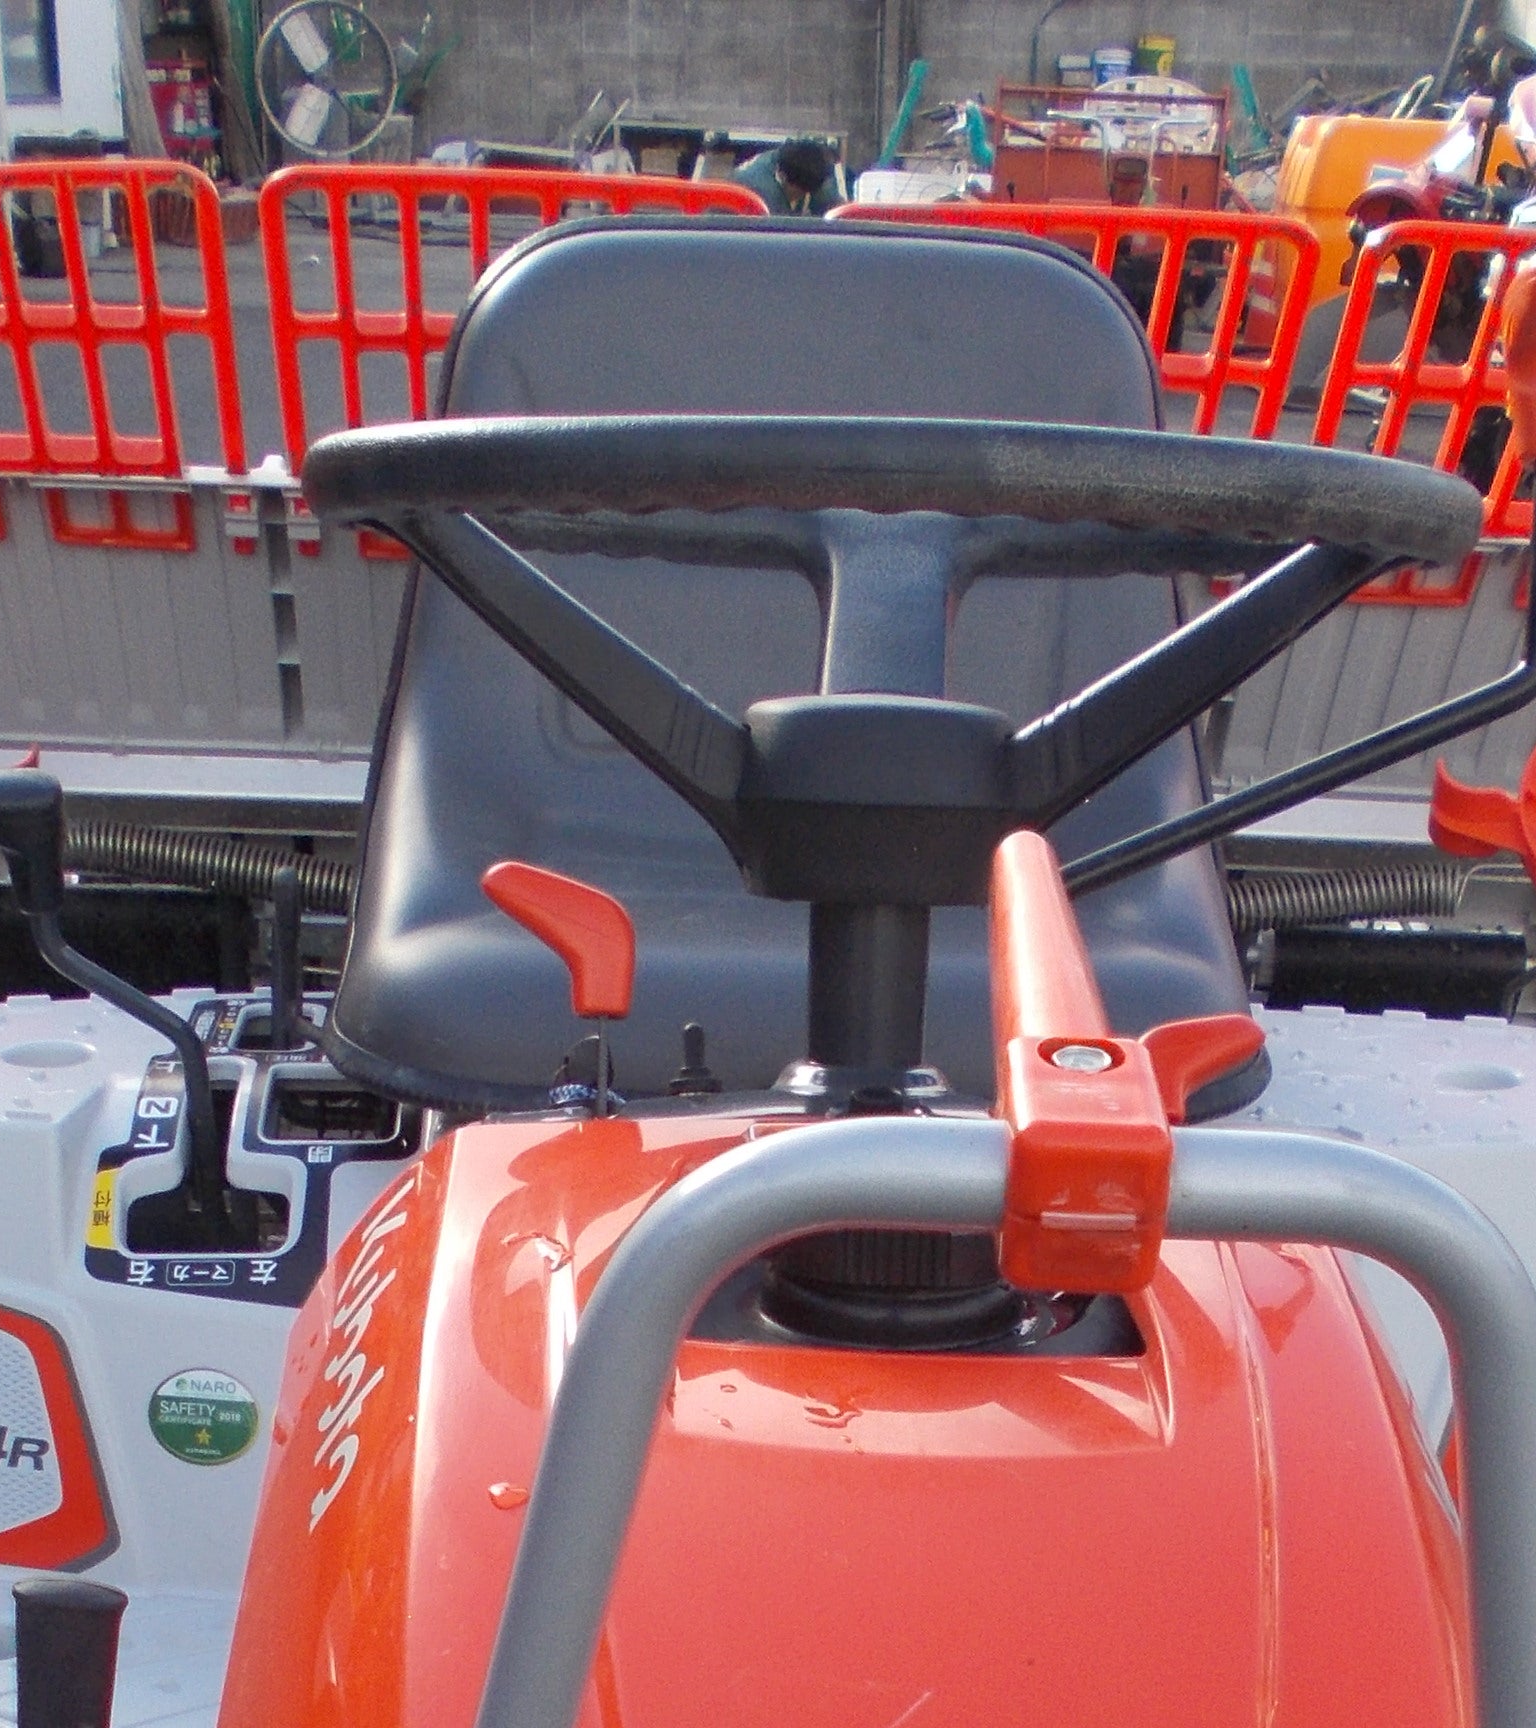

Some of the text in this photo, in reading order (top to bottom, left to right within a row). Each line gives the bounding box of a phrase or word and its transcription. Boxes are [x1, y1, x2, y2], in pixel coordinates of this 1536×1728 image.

[133, 1124, 169, 1148] 下
[92, 1189, 112, 1228] 植付
[126, 1260, 278, 1286] 左 マーカ 右
[308, 1178, 416, 1535] Kubota
[190, 1380, 236, 1393] NARO
[160, 1401, 216, 1415] SAFETY
